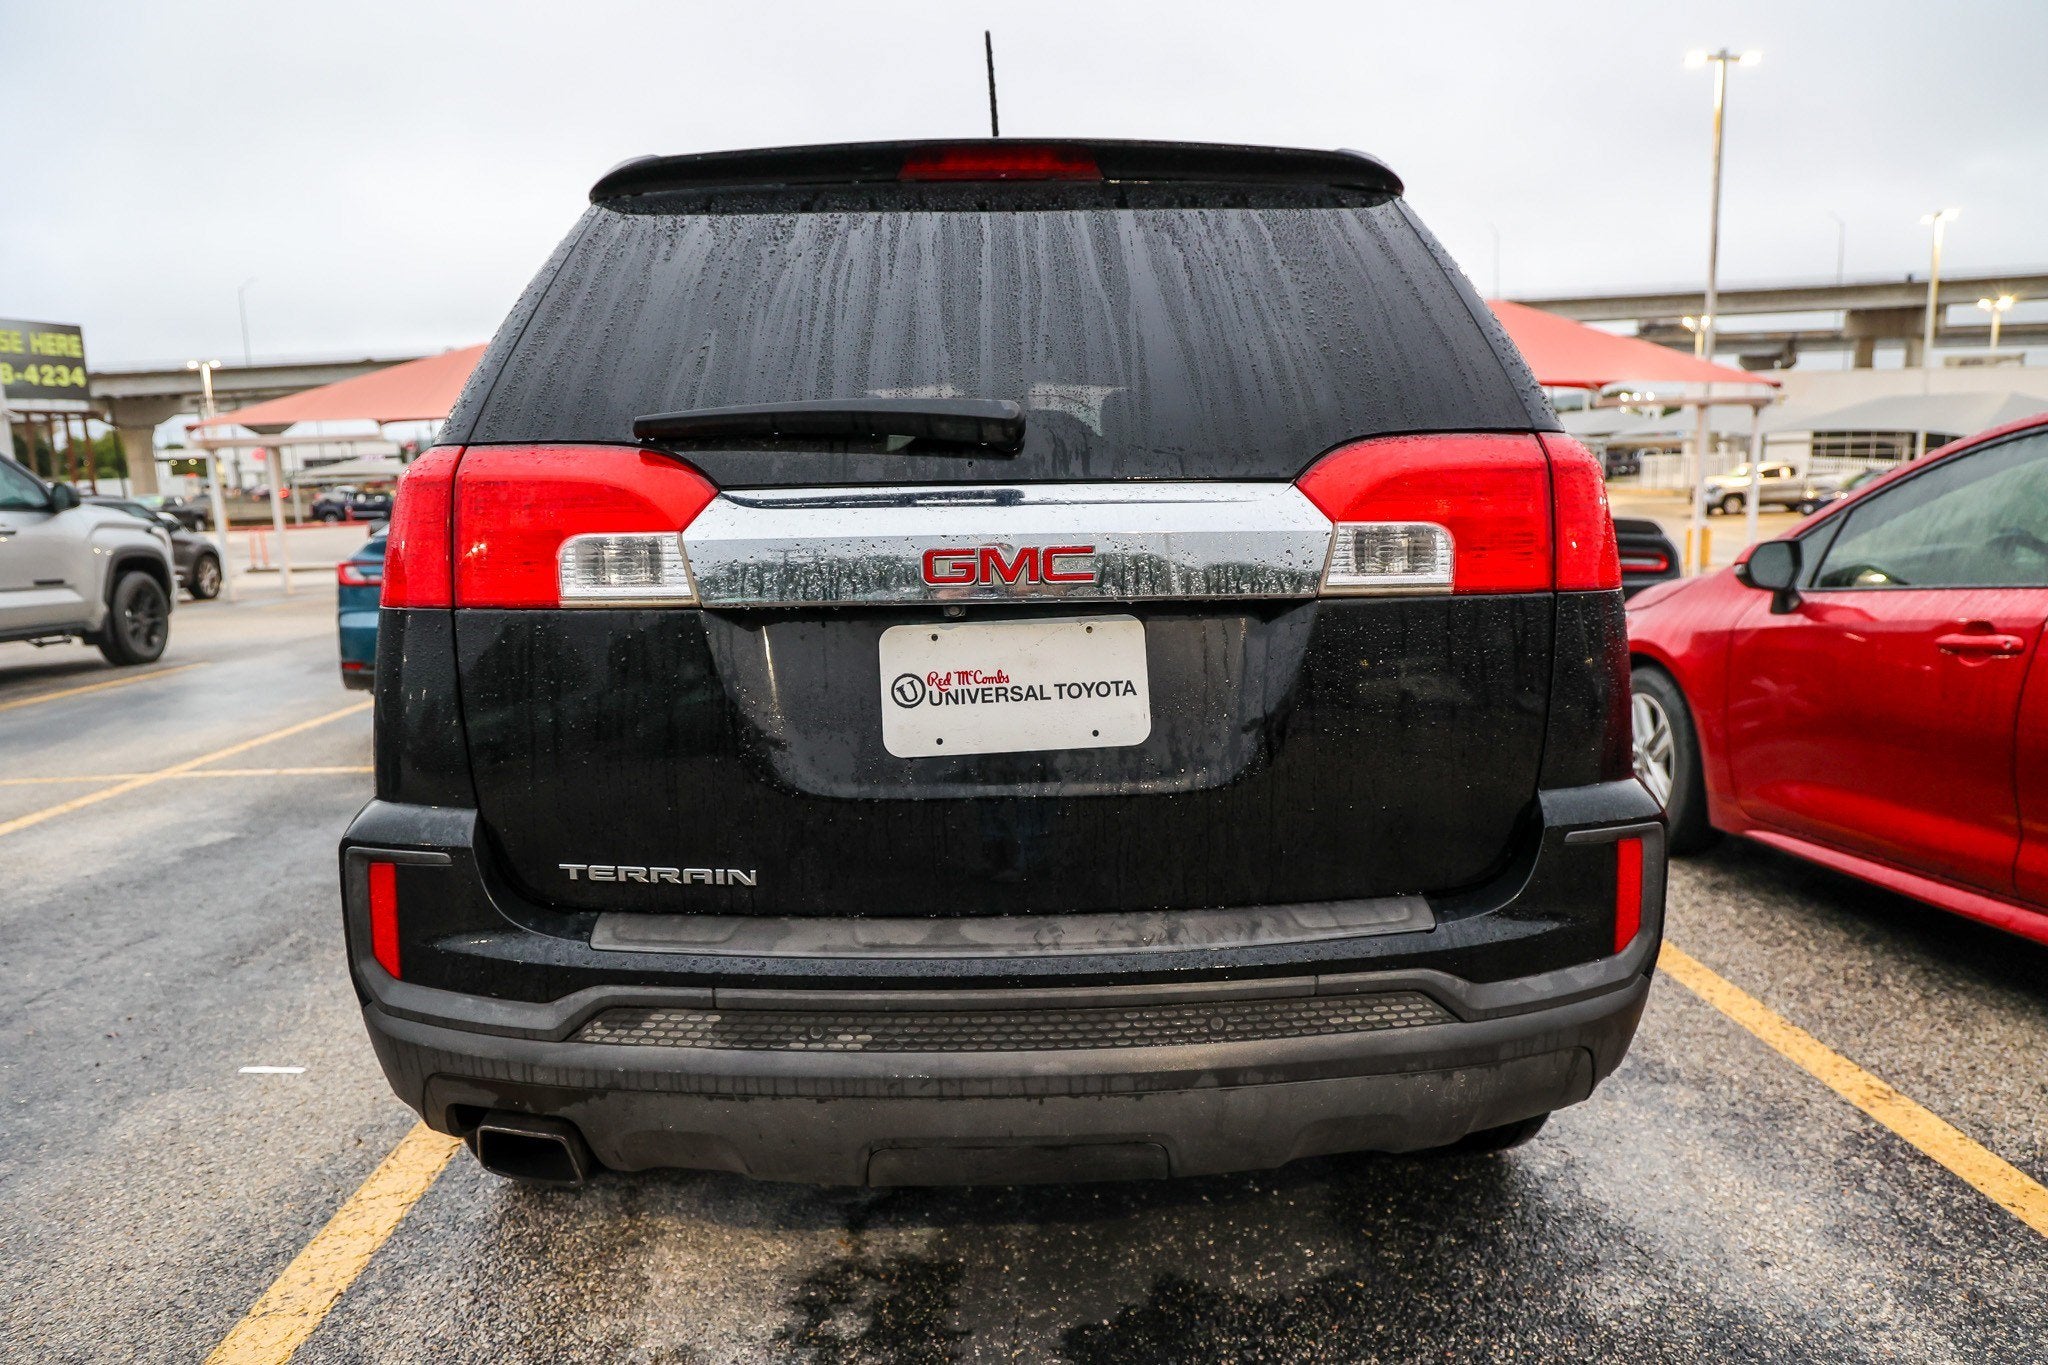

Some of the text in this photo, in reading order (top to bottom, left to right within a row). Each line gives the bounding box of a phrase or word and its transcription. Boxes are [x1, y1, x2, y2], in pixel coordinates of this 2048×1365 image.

[29, 331, 83, 358] HERE
[921, 545, 1096, 586] GMC
[927, 669, 1010, 692] Red McCombs
[929, 680, 1138, 706] UNIVERSAL TOYOTA
[558, 863, 757, 886] TERRAIN
